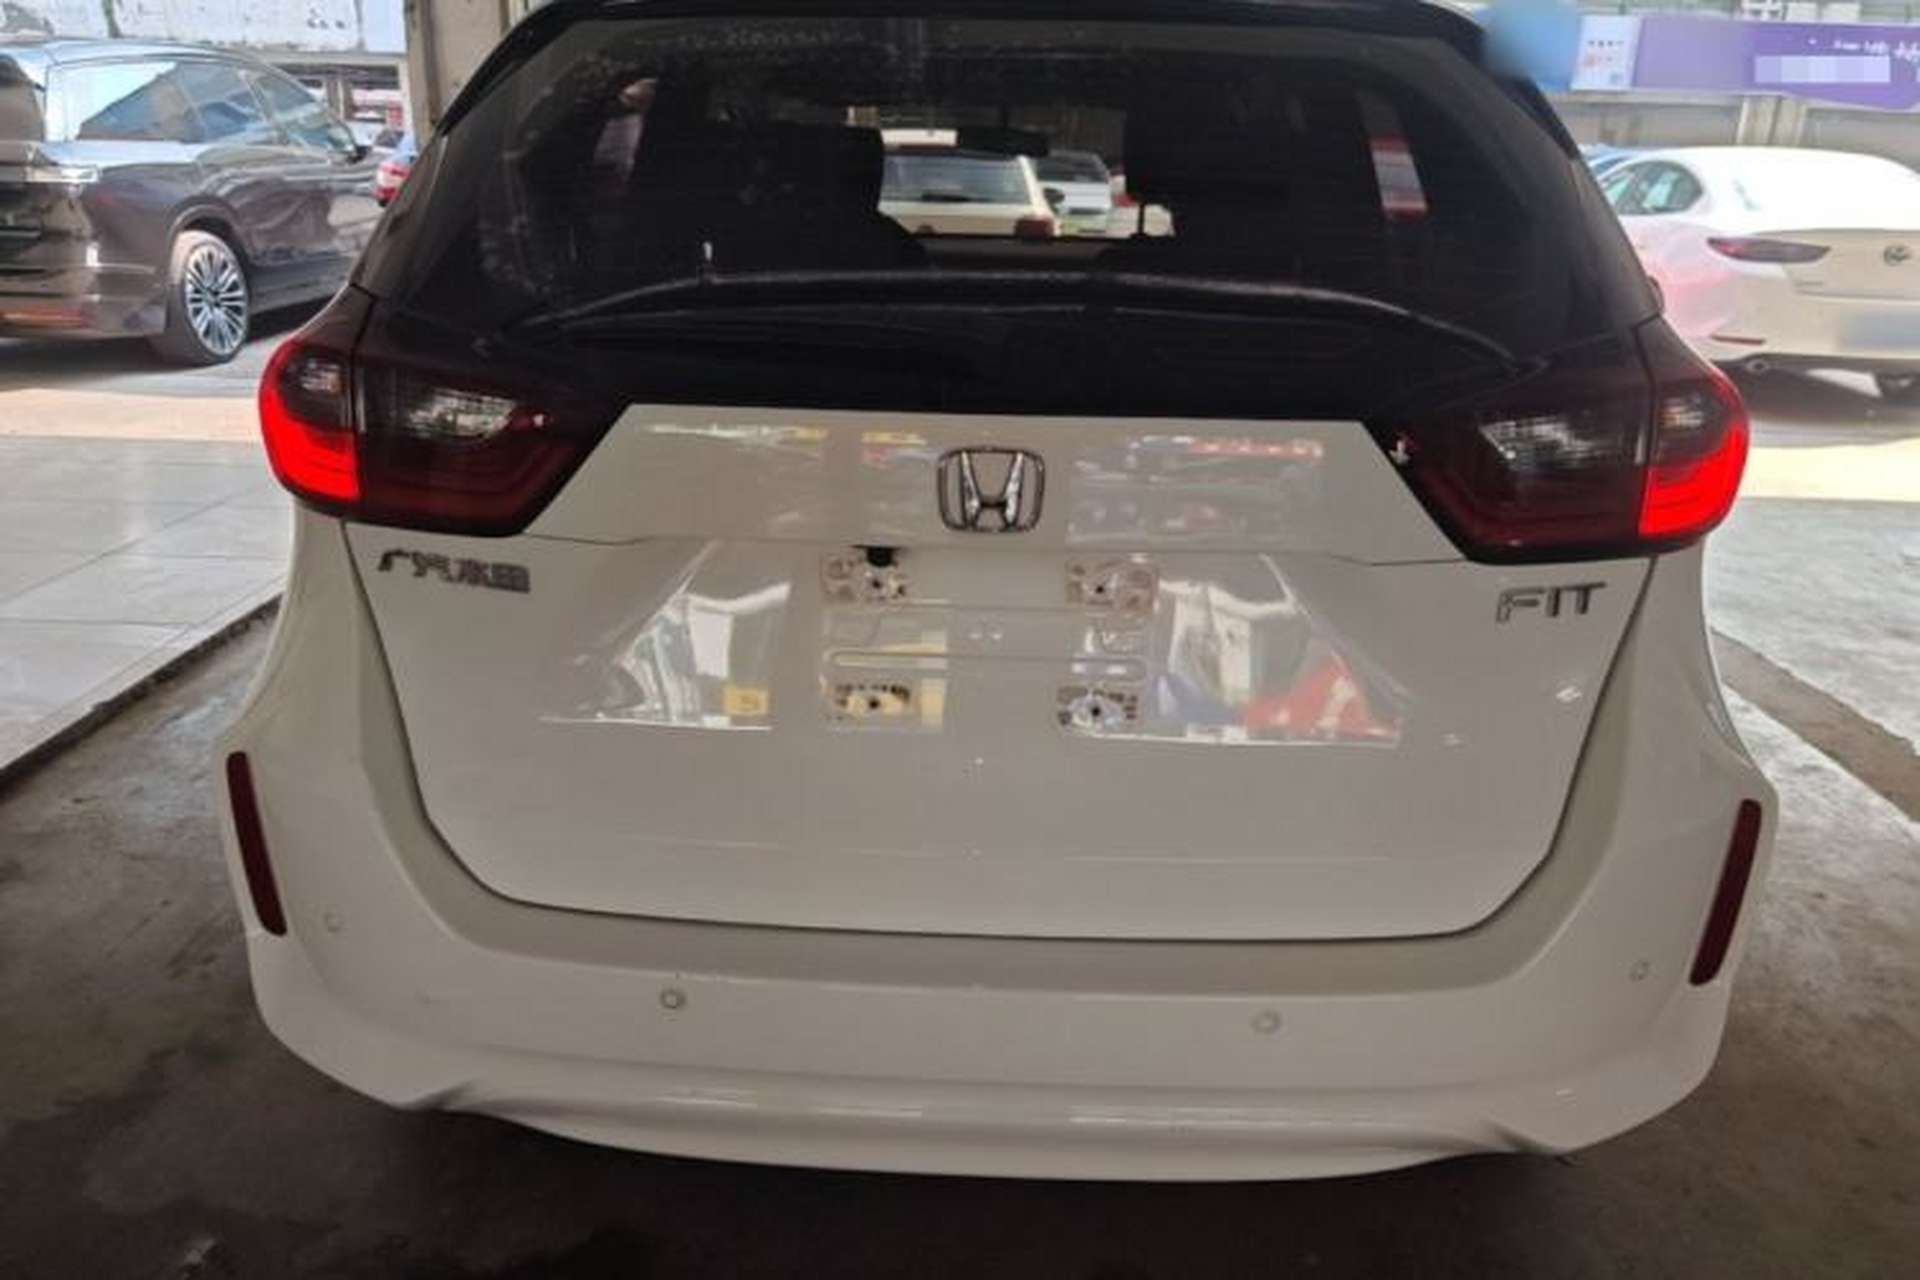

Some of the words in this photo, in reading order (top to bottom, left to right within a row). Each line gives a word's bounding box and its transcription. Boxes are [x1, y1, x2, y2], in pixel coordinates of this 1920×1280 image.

[376, 549, 532, 594] 广汽本田
[1496, 581, 1607, 624] FIT
